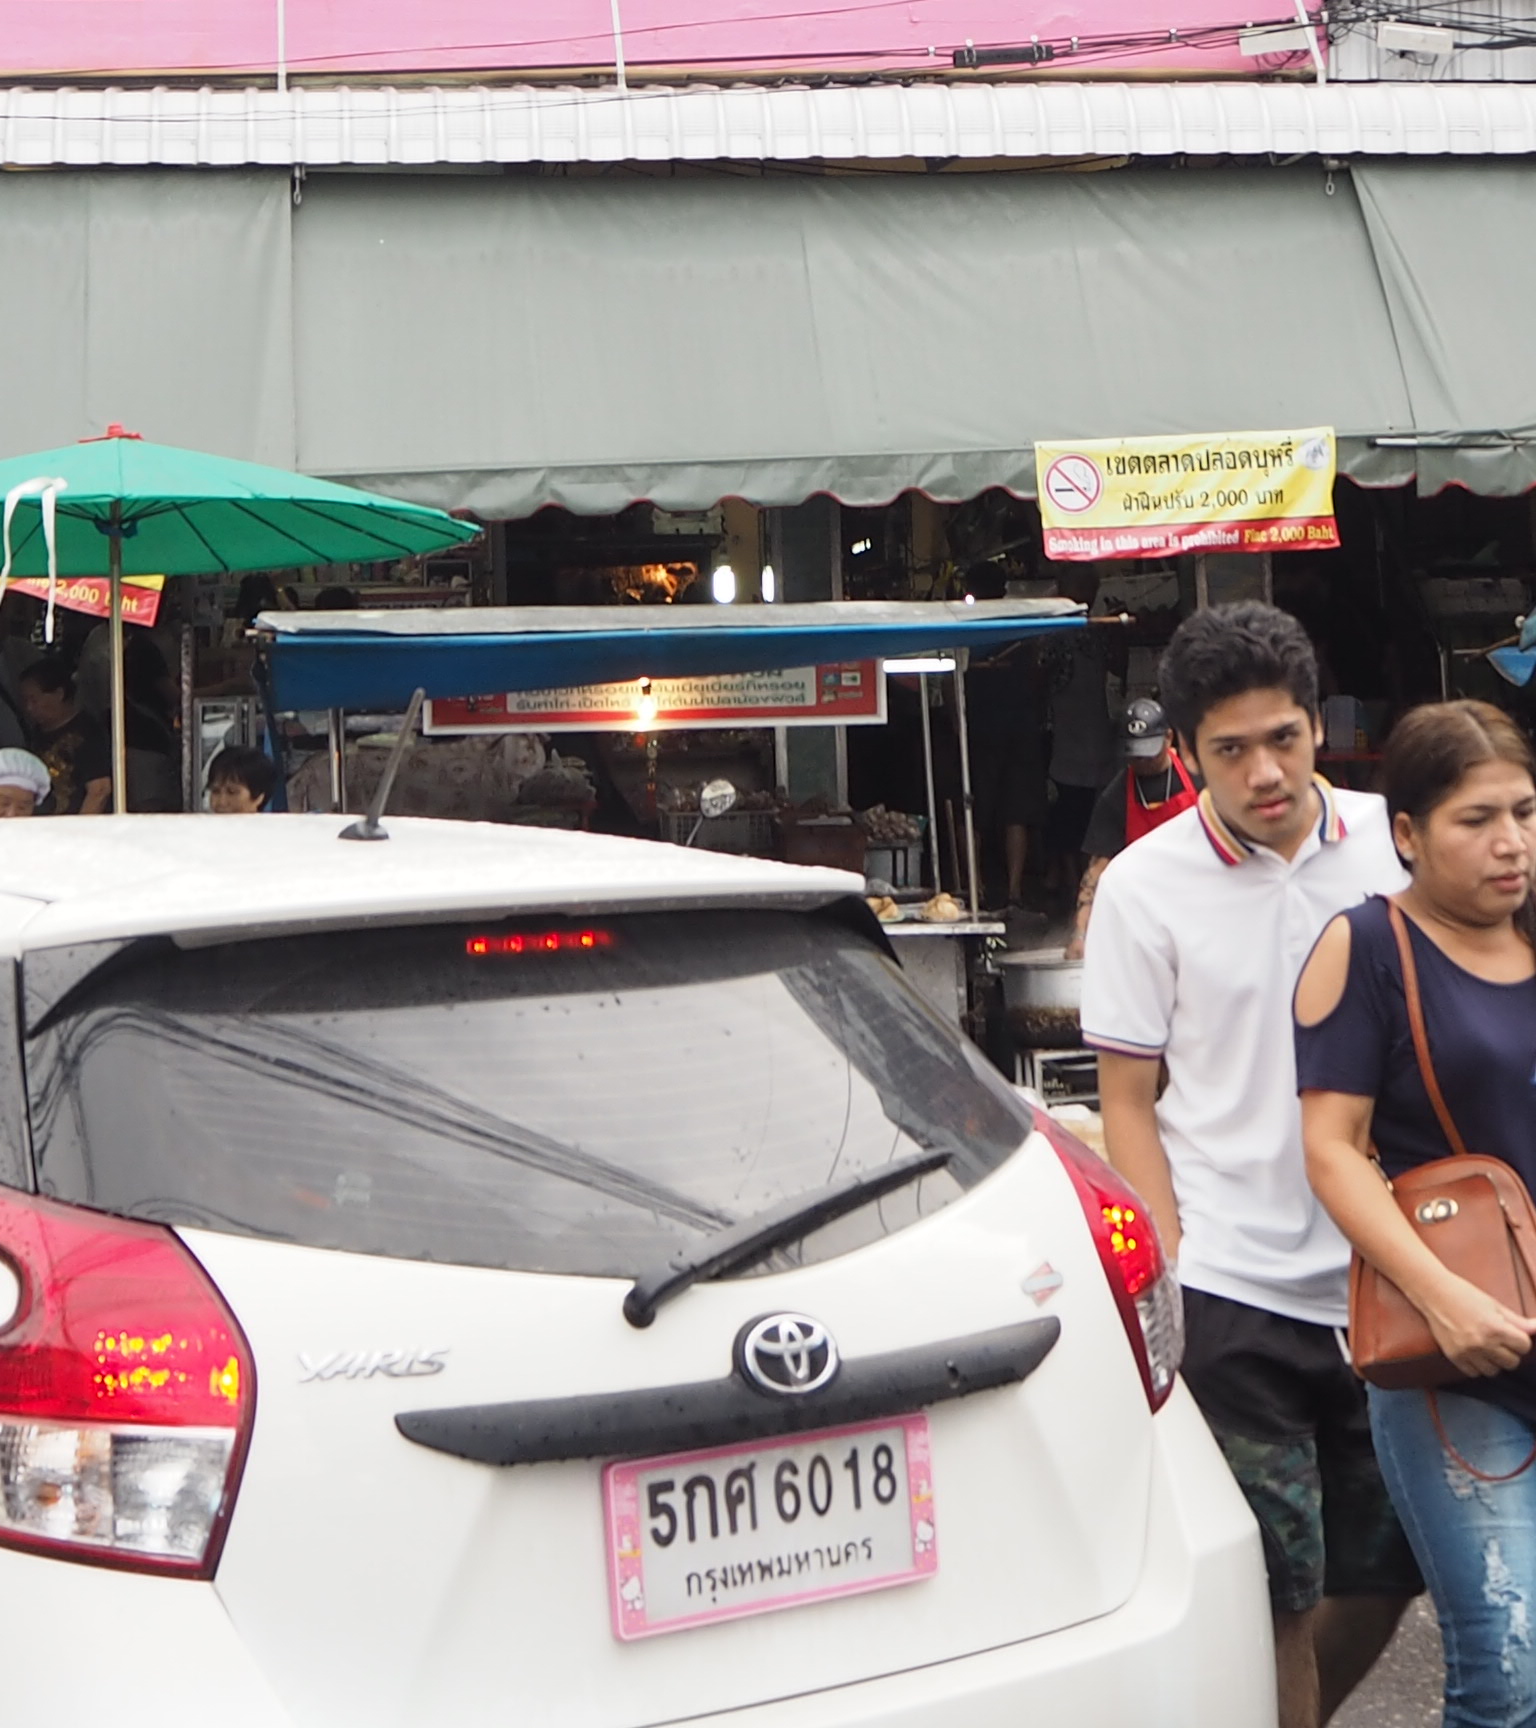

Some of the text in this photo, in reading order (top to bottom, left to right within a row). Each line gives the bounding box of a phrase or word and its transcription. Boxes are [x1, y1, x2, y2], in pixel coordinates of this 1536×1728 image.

[1106, 436, 1294, 478] เขตตลาดปลอดบุหรี่
[1199, 488, 1249, 511] 2,000
[1255, 487, 1284, 506] บาท
[1048, 537, 1099, 555] Smoking
[1100, 536, 1113, 551] in
[1116, 535, 1139, 550] this
[1141, 535, 1165, 549] area
[1168, 532, 1179, 548] is
[1181, 529, 1240, 551] prohibited
[1269, 526, 1305, 543] 2,000
[1306, 524, 1335, 540] Baht
[55, 579, 99, 604] 2,000
[297, 1346, 450, 1384] YARIS
[646, 1442, 897, 1548] 5กศ 6018
[685, 1535, 874, 1604] กรุงเทพมหานคร
